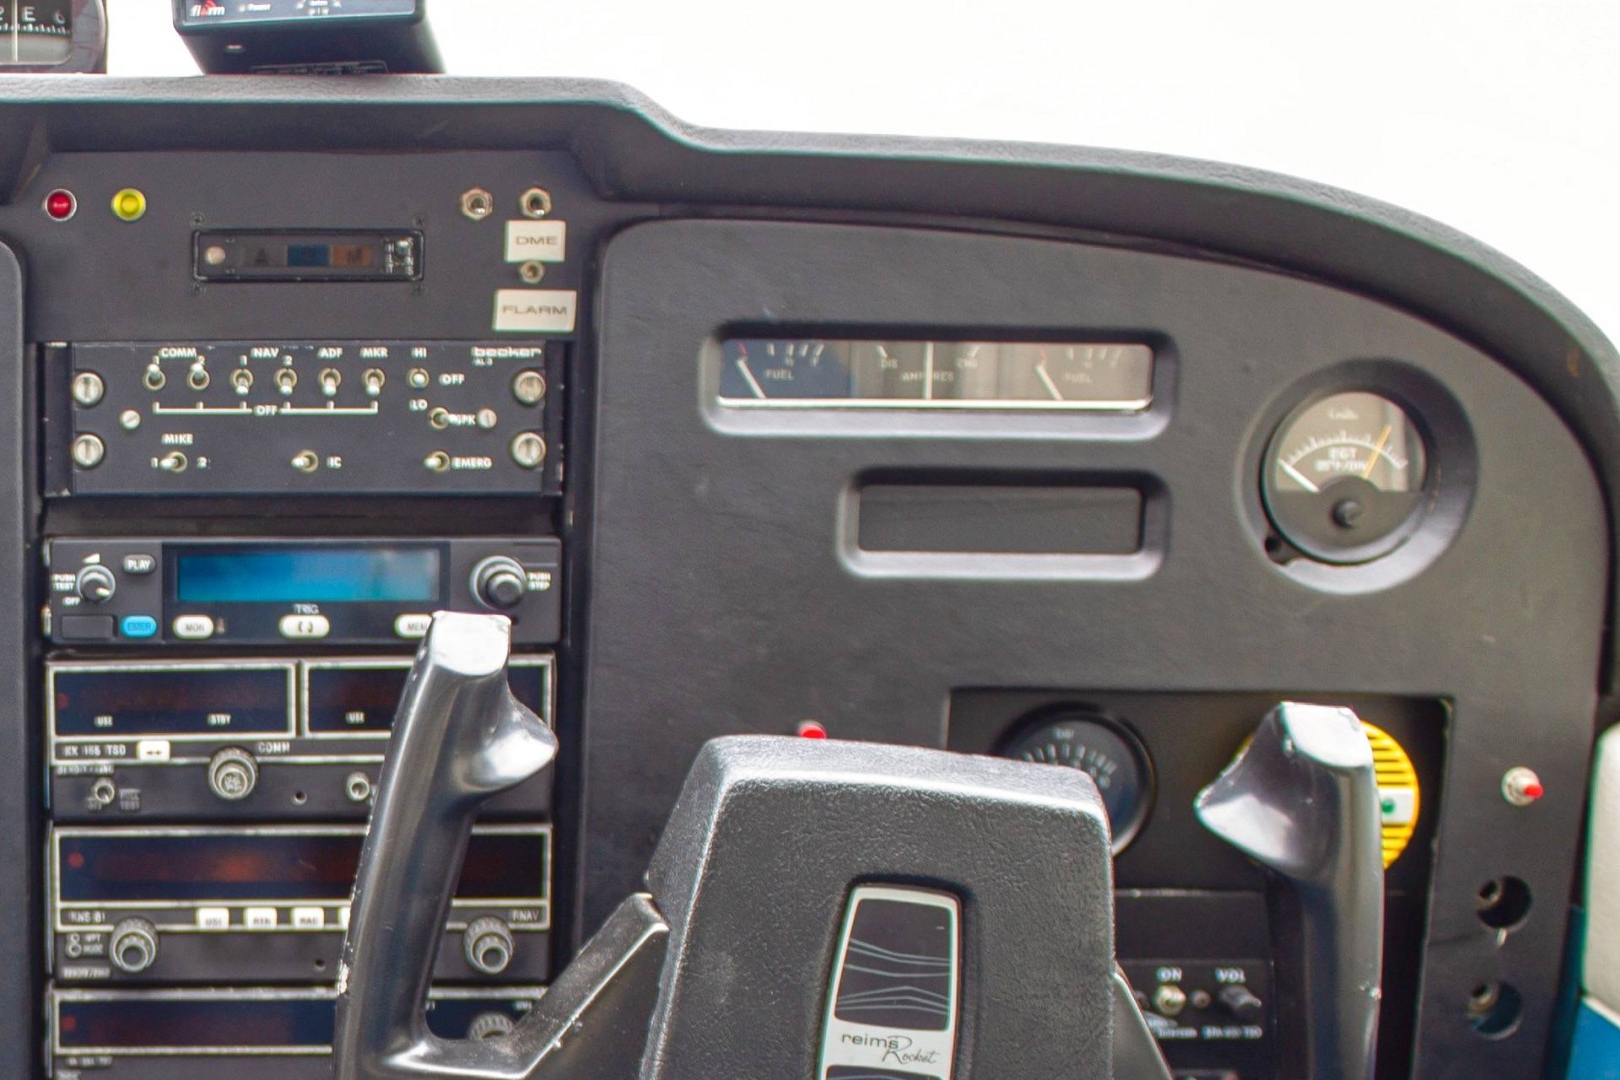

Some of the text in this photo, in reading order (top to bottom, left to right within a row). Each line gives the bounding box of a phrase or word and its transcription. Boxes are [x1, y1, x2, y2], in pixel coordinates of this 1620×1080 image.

[23, 6, 36, 21] E
[53, 9, 66, 24] 6
[516, 234, 557, 246] DME
[502, 304, 568, 316] FLARM
[159, 348, 196, 358] COMM
[251, 348, 279, 358] NAV
[317, 348, 342, 359] ADF
[360, 348, 388, 359] MKR
[412, 347, 427, 357] HI
[471, 347, 541, 357] becker
[240, 355, 247, 366] 1
[283, 355, 292, 366] 2
[881, 359, 898, 368] DIS
[439, 373, 464, 385] OFF
[765, 369, 794, 379] FUEL
[1065, 373, 1092, 383] FUEL
[254, 405, 277, 416] OFF
[409, 399, 427, 411] LO
[162, 434, 193, 444] MIKE
[1328, 447, 1357, 459] EGT
[151, 457, 158, 468] 1
[197, 457, 207, 468] 2
[327, 456, 341, 468] IC
[451, 457, 492, 468] EMERG
[126, 559, 150, 571] PLAY
[62, 597, 80, 606] OFF
[293, 603, 320, 614] TRIG
[95, 716, 113, 727] USE
[208, 714, 231, 725] STBY
[346, 711, 365, 724] USE
[64, 745, 79, 756] KX
[105, 745, 126, 756] TSO
[258, 742, 290, 753] COMM
[509, 910, 540, 921] RNAV
[1157, 967, 1182, 982] ON
[1216, 968, 1246, 983] VOL
[842, 1034, 899, 1050] reims
[882, 1035, 940, 1065] Rocket
